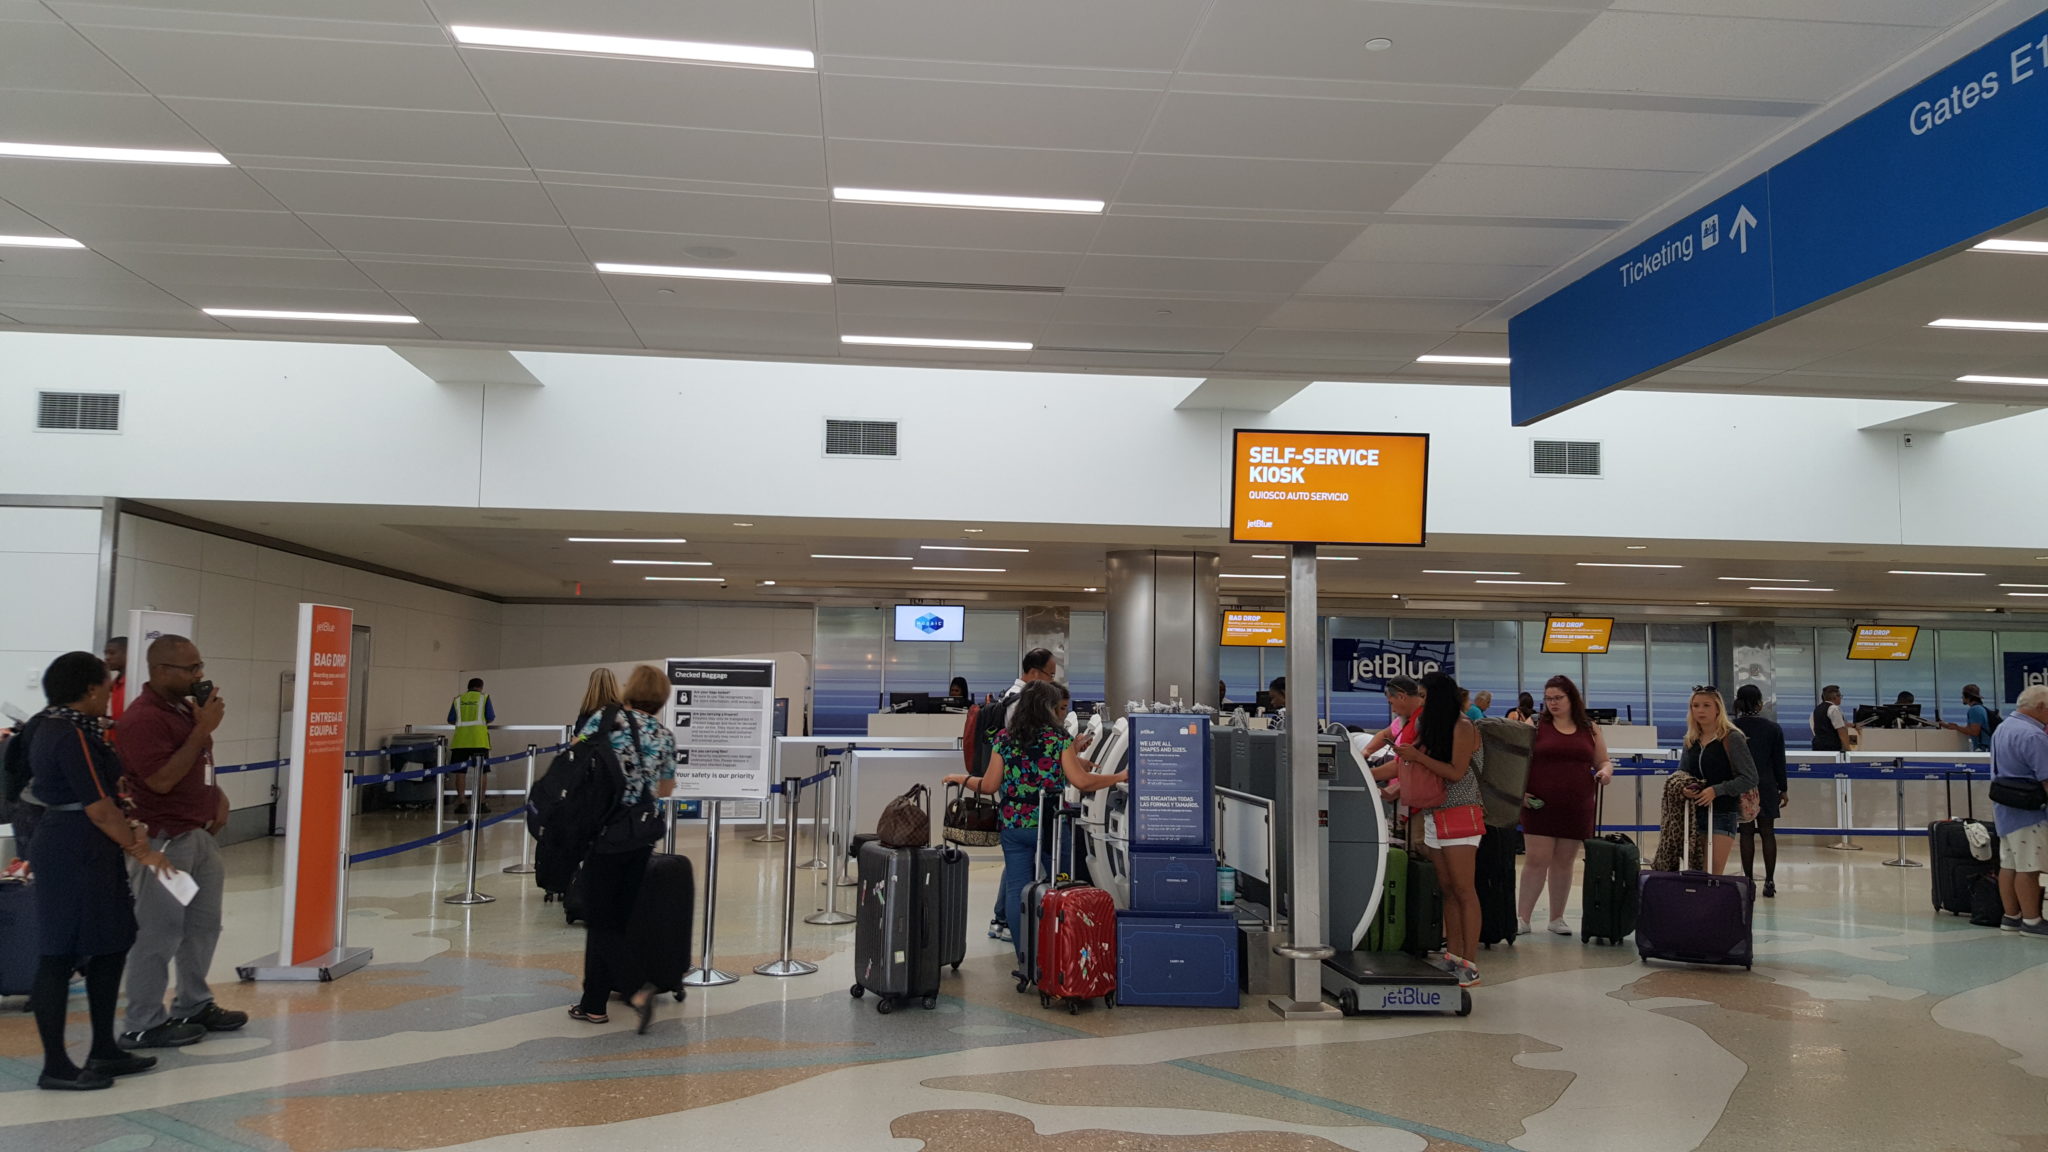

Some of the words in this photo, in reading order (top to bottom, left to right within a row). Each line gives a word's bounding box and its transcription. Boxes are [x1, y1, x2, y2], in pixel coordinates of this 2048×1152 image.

[1910, 71, 1999, 136] Gates
[1620, 234, 1693, 287] Ticketing
[1249, 446, 1380, 466] SELF-SERVICE
[1249, 466, 1306, 483] KIOSK
[1249, 490, 1286, 500] QUIOSCO
[1286, 491, 1310, 501] AUTO
[1310, 492, 1349, 502] SERVICIO
[1246, 519, 1273, 529] jetBlue
[314, 652, 332, 667] BAG
[332, 653, 346, 667] DROP
[1350, 652, 1439, 684] jetBlue
[701, 672, 728, 680] Baggage
[309, 724, 338, 737] EQUIPAJE
[1382, 987, 1441, 1008] jetBlue
